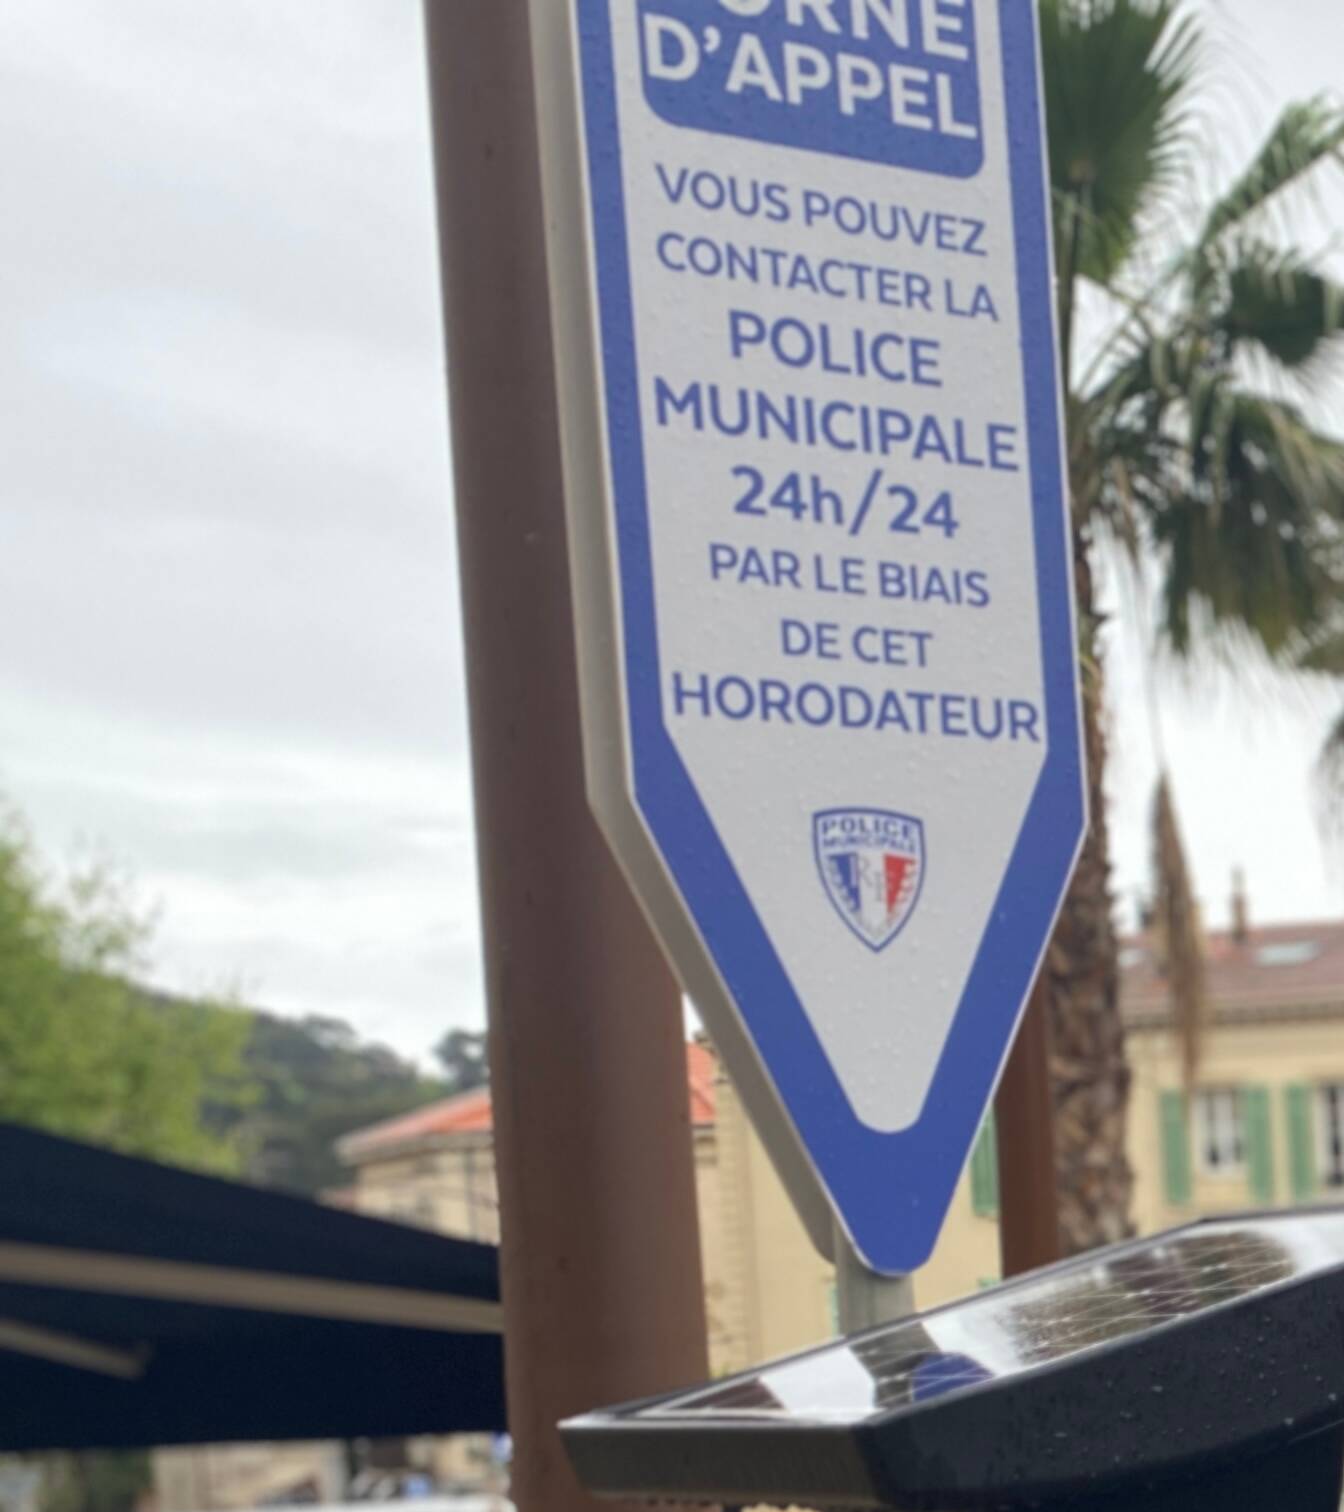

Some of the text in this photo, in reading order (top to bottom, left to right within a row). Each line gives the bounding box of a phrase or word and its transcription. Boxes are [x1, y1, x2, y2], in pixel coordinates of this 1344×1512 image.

[643, 12, 977, 139] D'APPEL
[655, 163, 987, 257] VOUS POUVEZ
[656, 232, 999, 322] CONTACTER LA
[728, 309, 943, 387] POLICE
[654, 376, 1020, 472] MUNICIPALE
[732, 465, 959, 538] 24h/24
[709, 543, 990, 608] PAR LE BIAIS
[780, 619, 932, 667] DE CET
[673, 672, 1041, 743] HORODATEUR
[822, 816, 913, 840] POLICE
